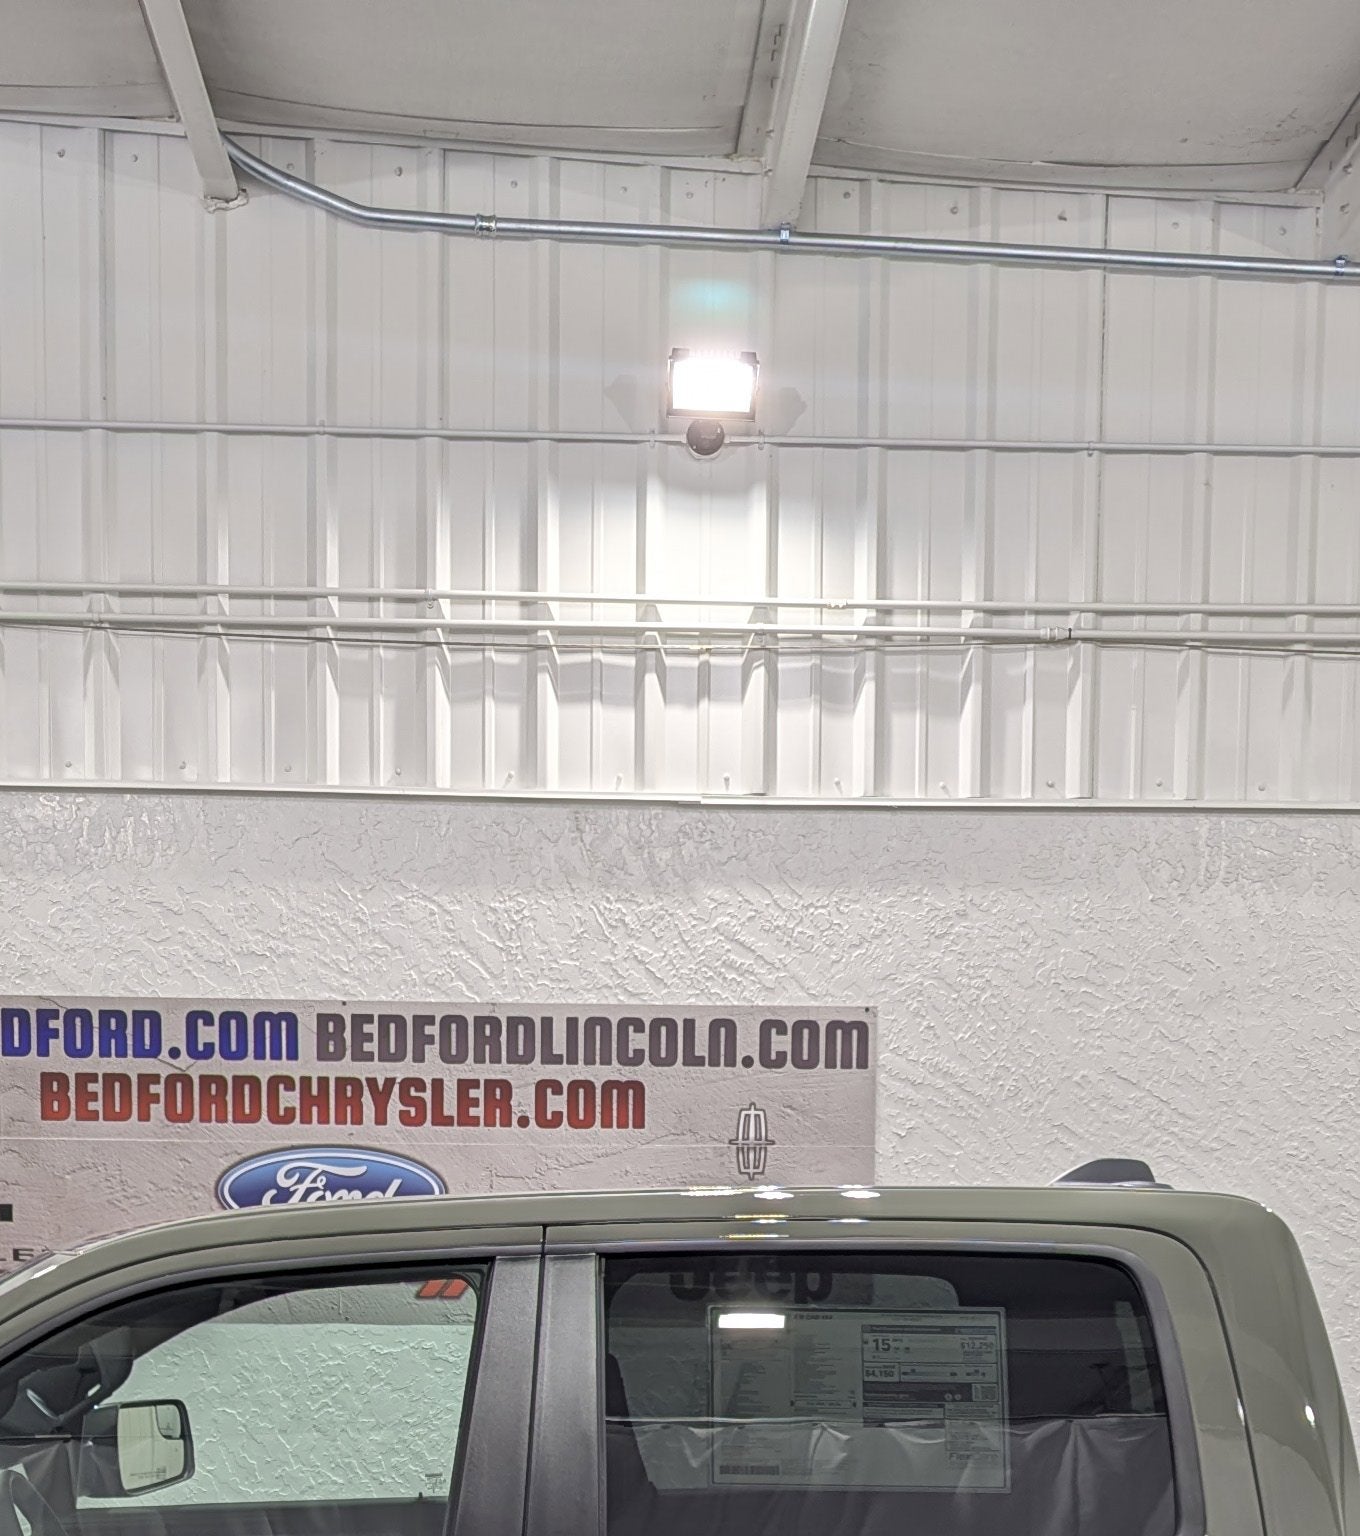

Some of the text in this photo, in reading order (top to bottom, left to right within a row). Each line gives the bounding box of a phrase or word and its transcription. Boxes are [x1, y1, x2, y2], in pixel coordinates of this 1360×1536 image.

[316, 1012, 869, 1070] BEDFORDLINCOLN.COM
[40, 1071, 646, 1130] BEDFORDCHRYSLER.COM
[872, 1339, 891, 1352] 15
